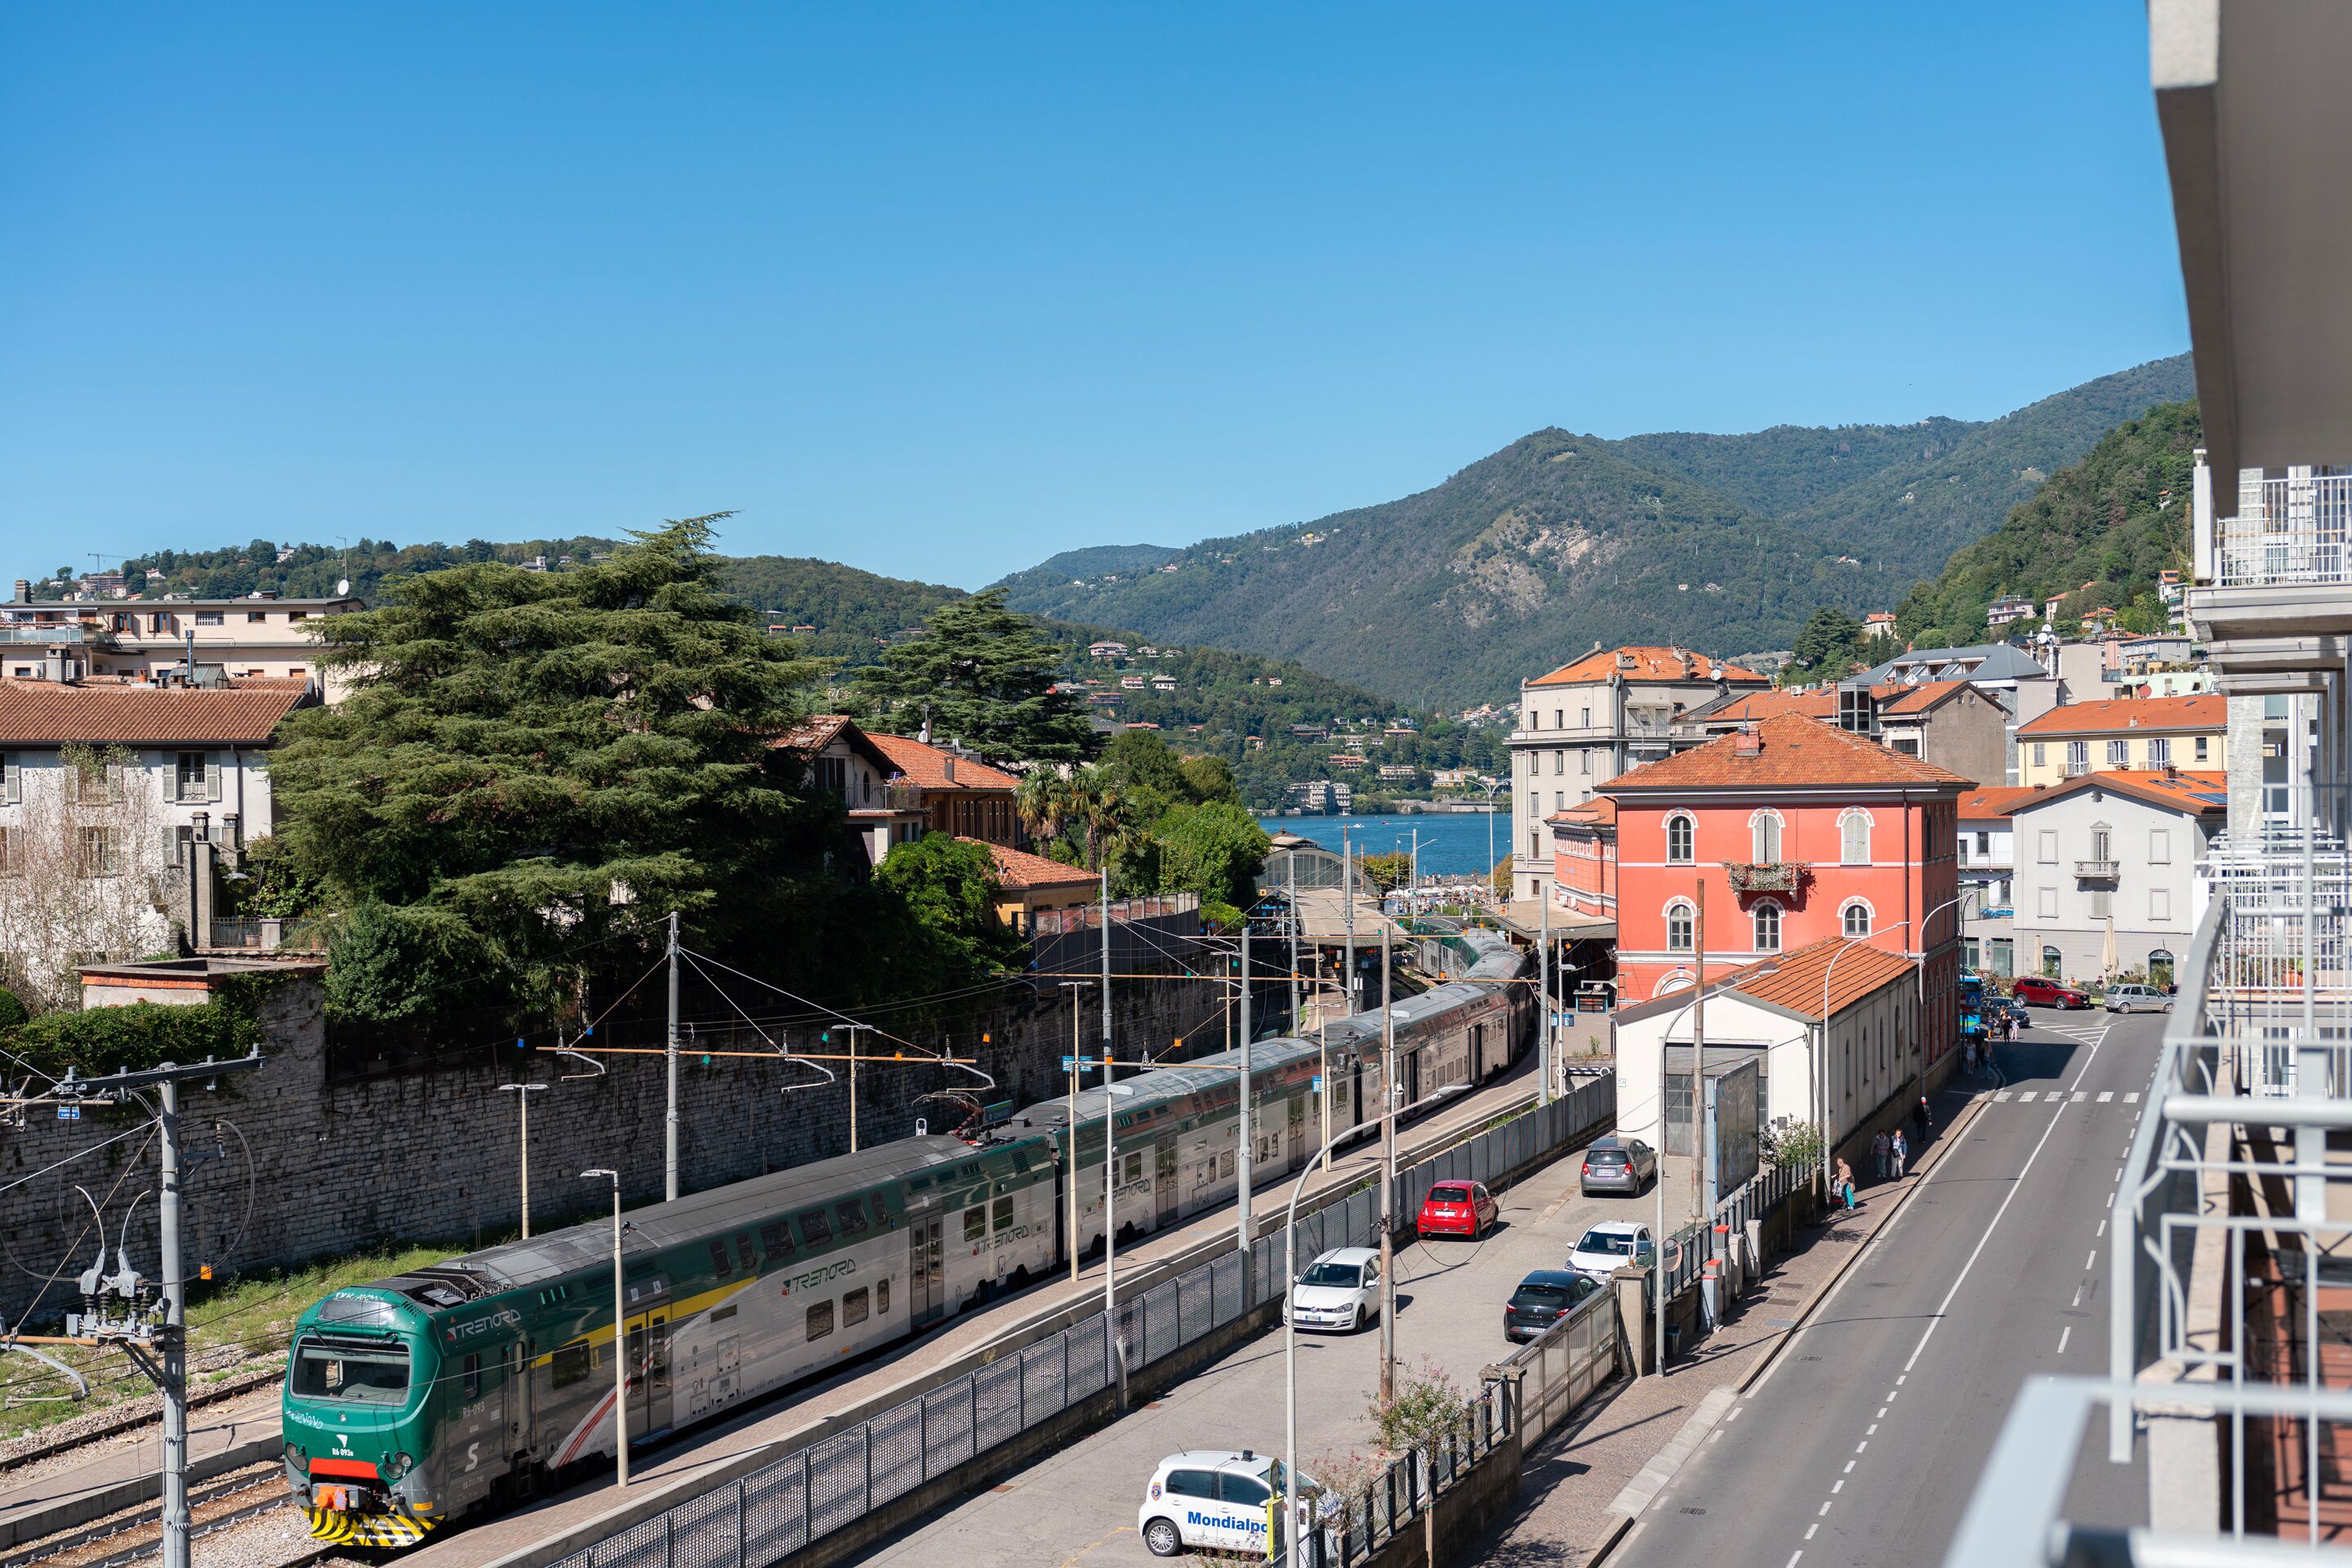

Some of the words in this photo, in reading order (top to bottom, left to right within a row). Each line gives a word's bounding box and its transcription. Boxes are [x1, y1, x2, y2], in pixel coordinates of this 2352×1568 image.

[1105, 1178, 1151, 1204] RENORD
[981, 1225, 1029, 1254] TRENORD
[792, 1258, 857, 1293] TRENORD
[456, 1309, 522, 1339] TRENORD
[462, 1401, 485, 1419] R6-093
[332, 1448, 340, 1456] R6
[464, 1441, 480, 1472] S
